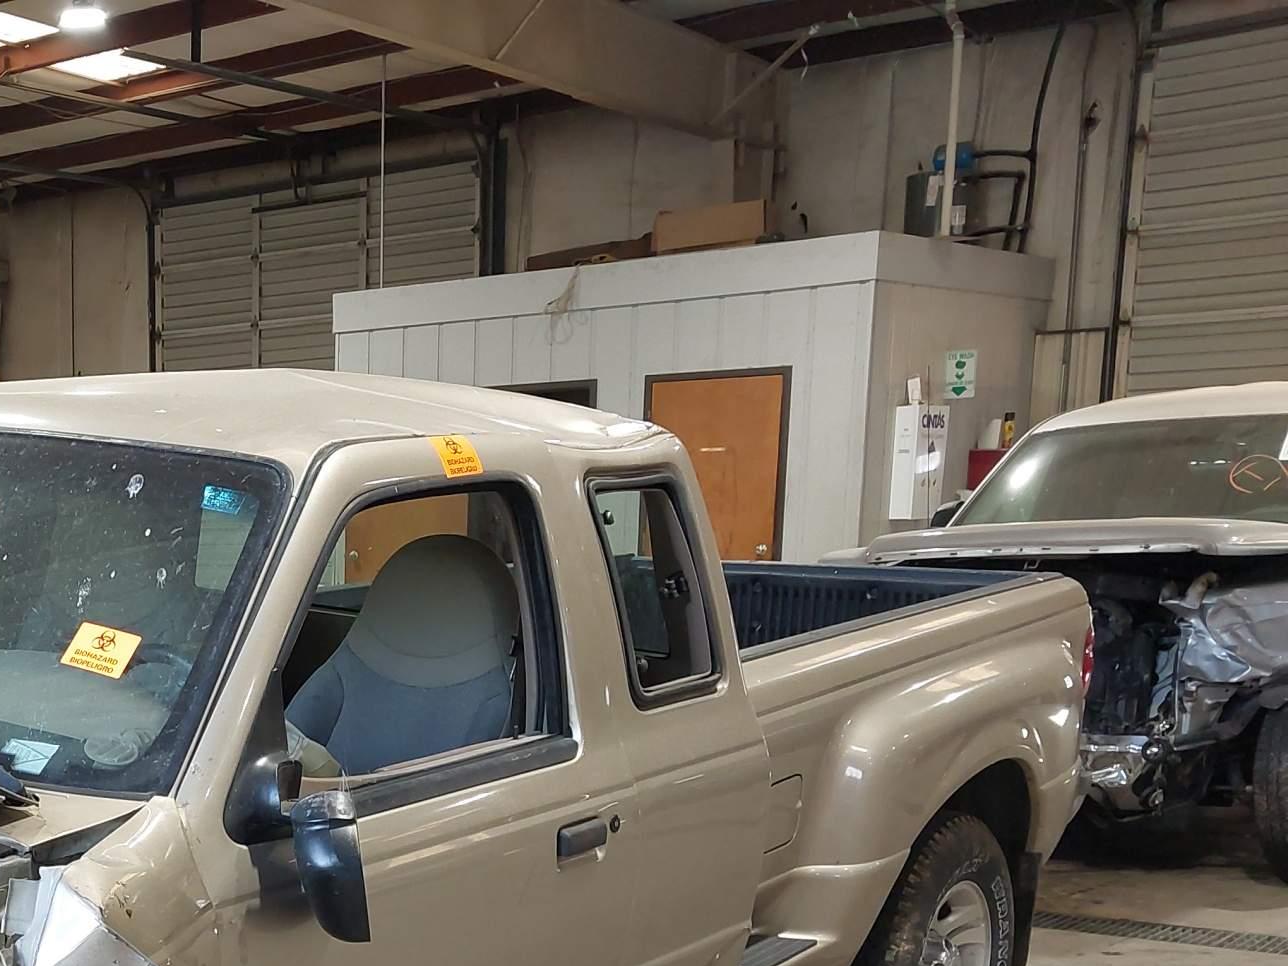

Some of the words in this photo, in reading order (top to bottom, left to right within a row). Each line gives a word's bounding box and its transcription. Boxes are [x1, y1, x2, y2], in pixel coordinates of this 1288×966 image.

[921, 411, 945, 429] CINTAS
[447, 456, 475, 466] BIOHAZARD
[69, 656, 114, 674] BIOPELIGRO
[73, 648, 119, 666] BIOHAZARD
